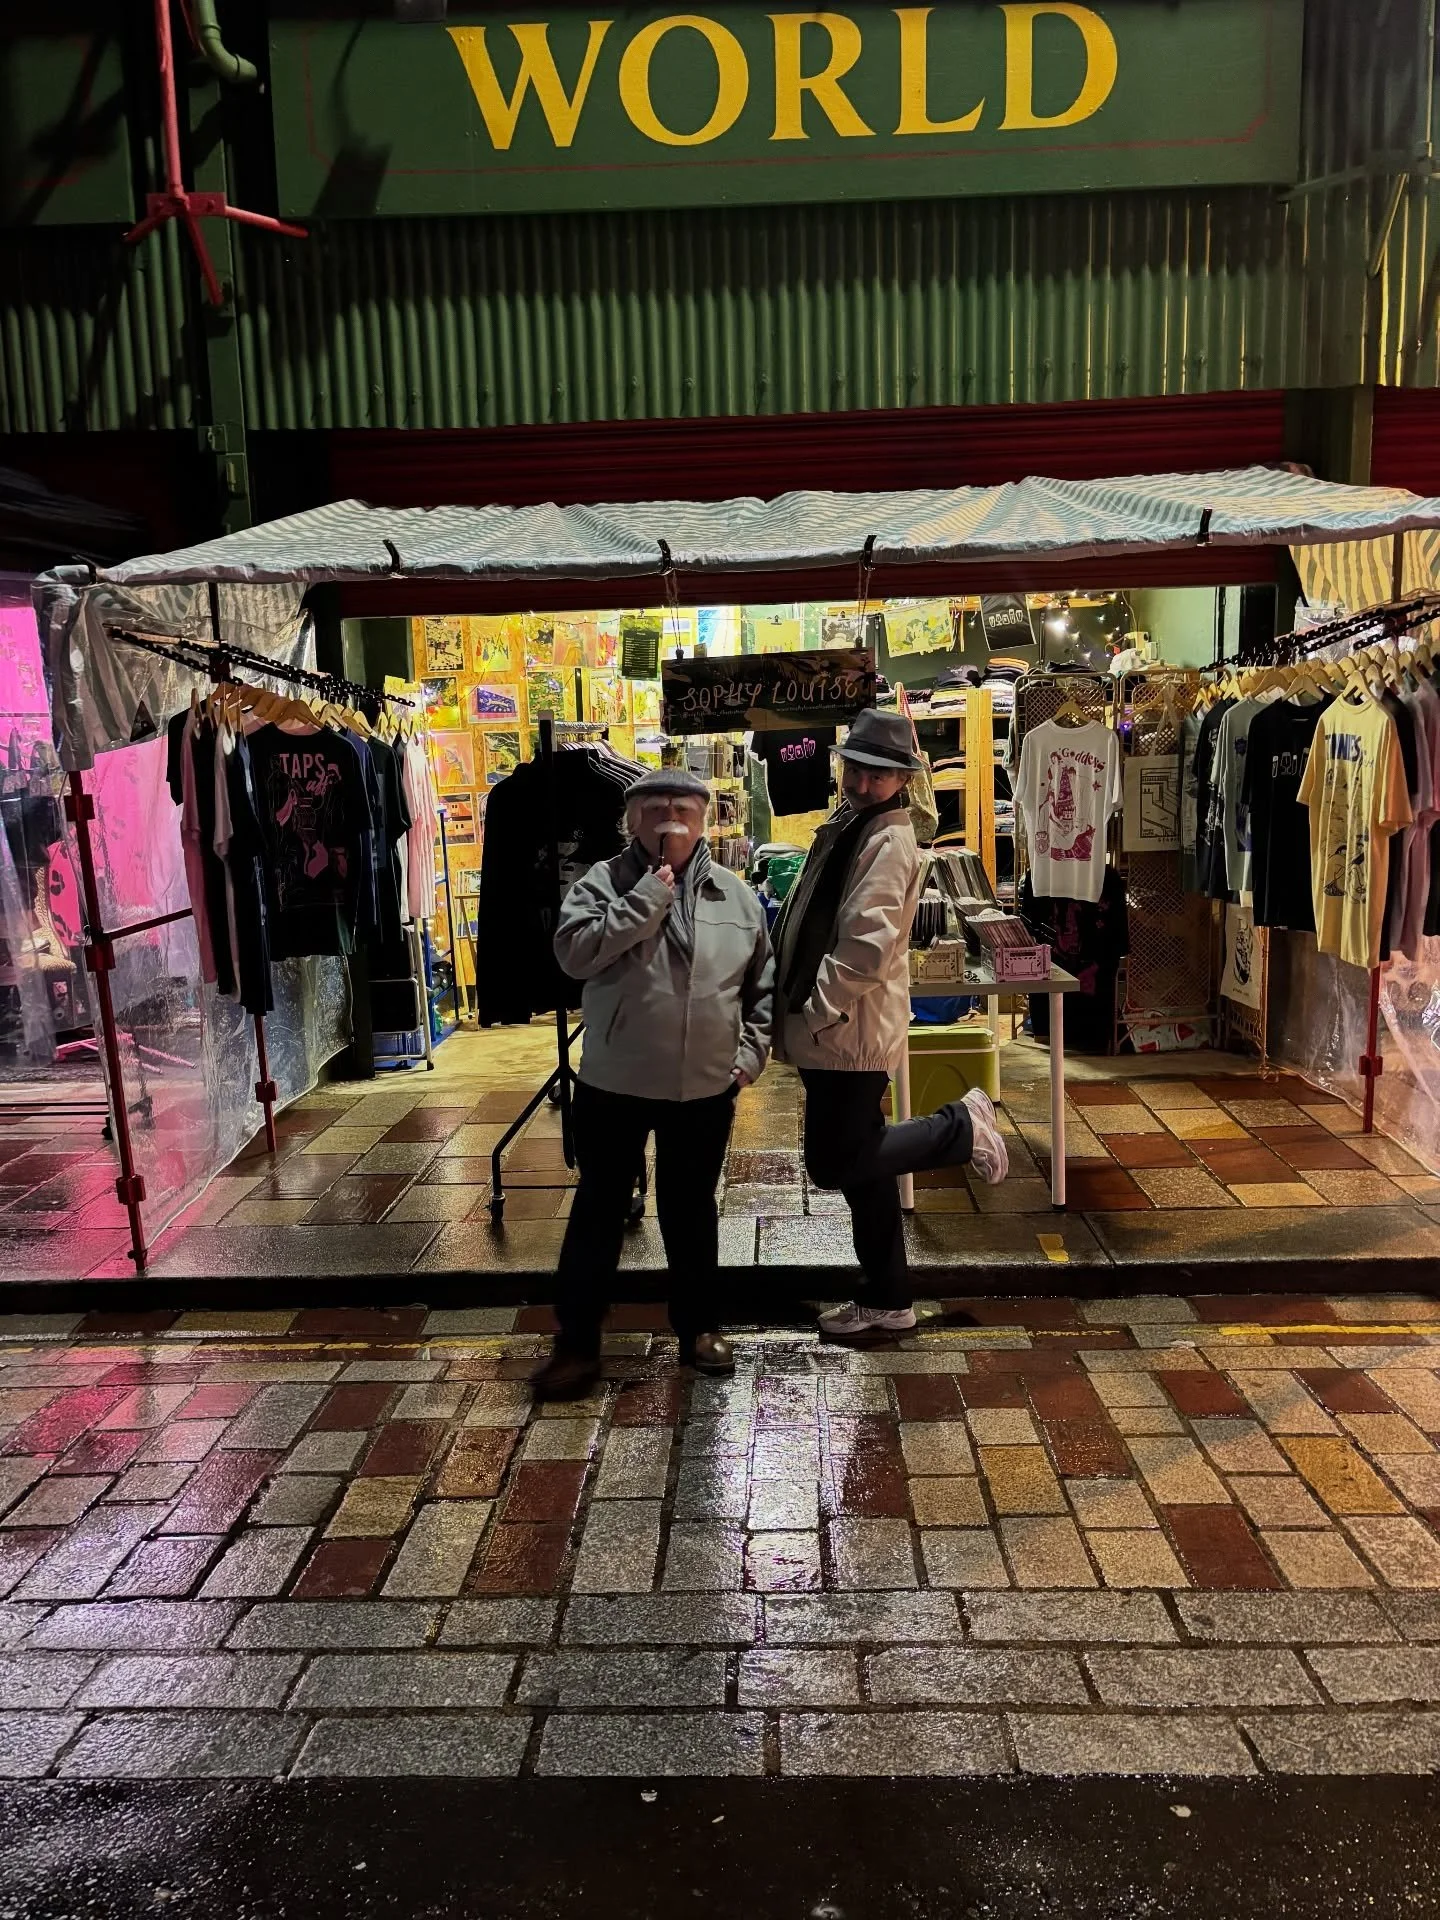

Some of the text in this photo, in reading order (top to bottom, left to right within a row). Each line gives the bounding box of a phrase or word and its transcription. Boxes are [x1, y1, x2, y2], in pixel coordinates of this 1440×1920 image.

[445, 1, 1118, 150] WORLD
[679, 675, 858, 711] SOPHY LOUISE
[279, 753, 326, 780] TAPS
